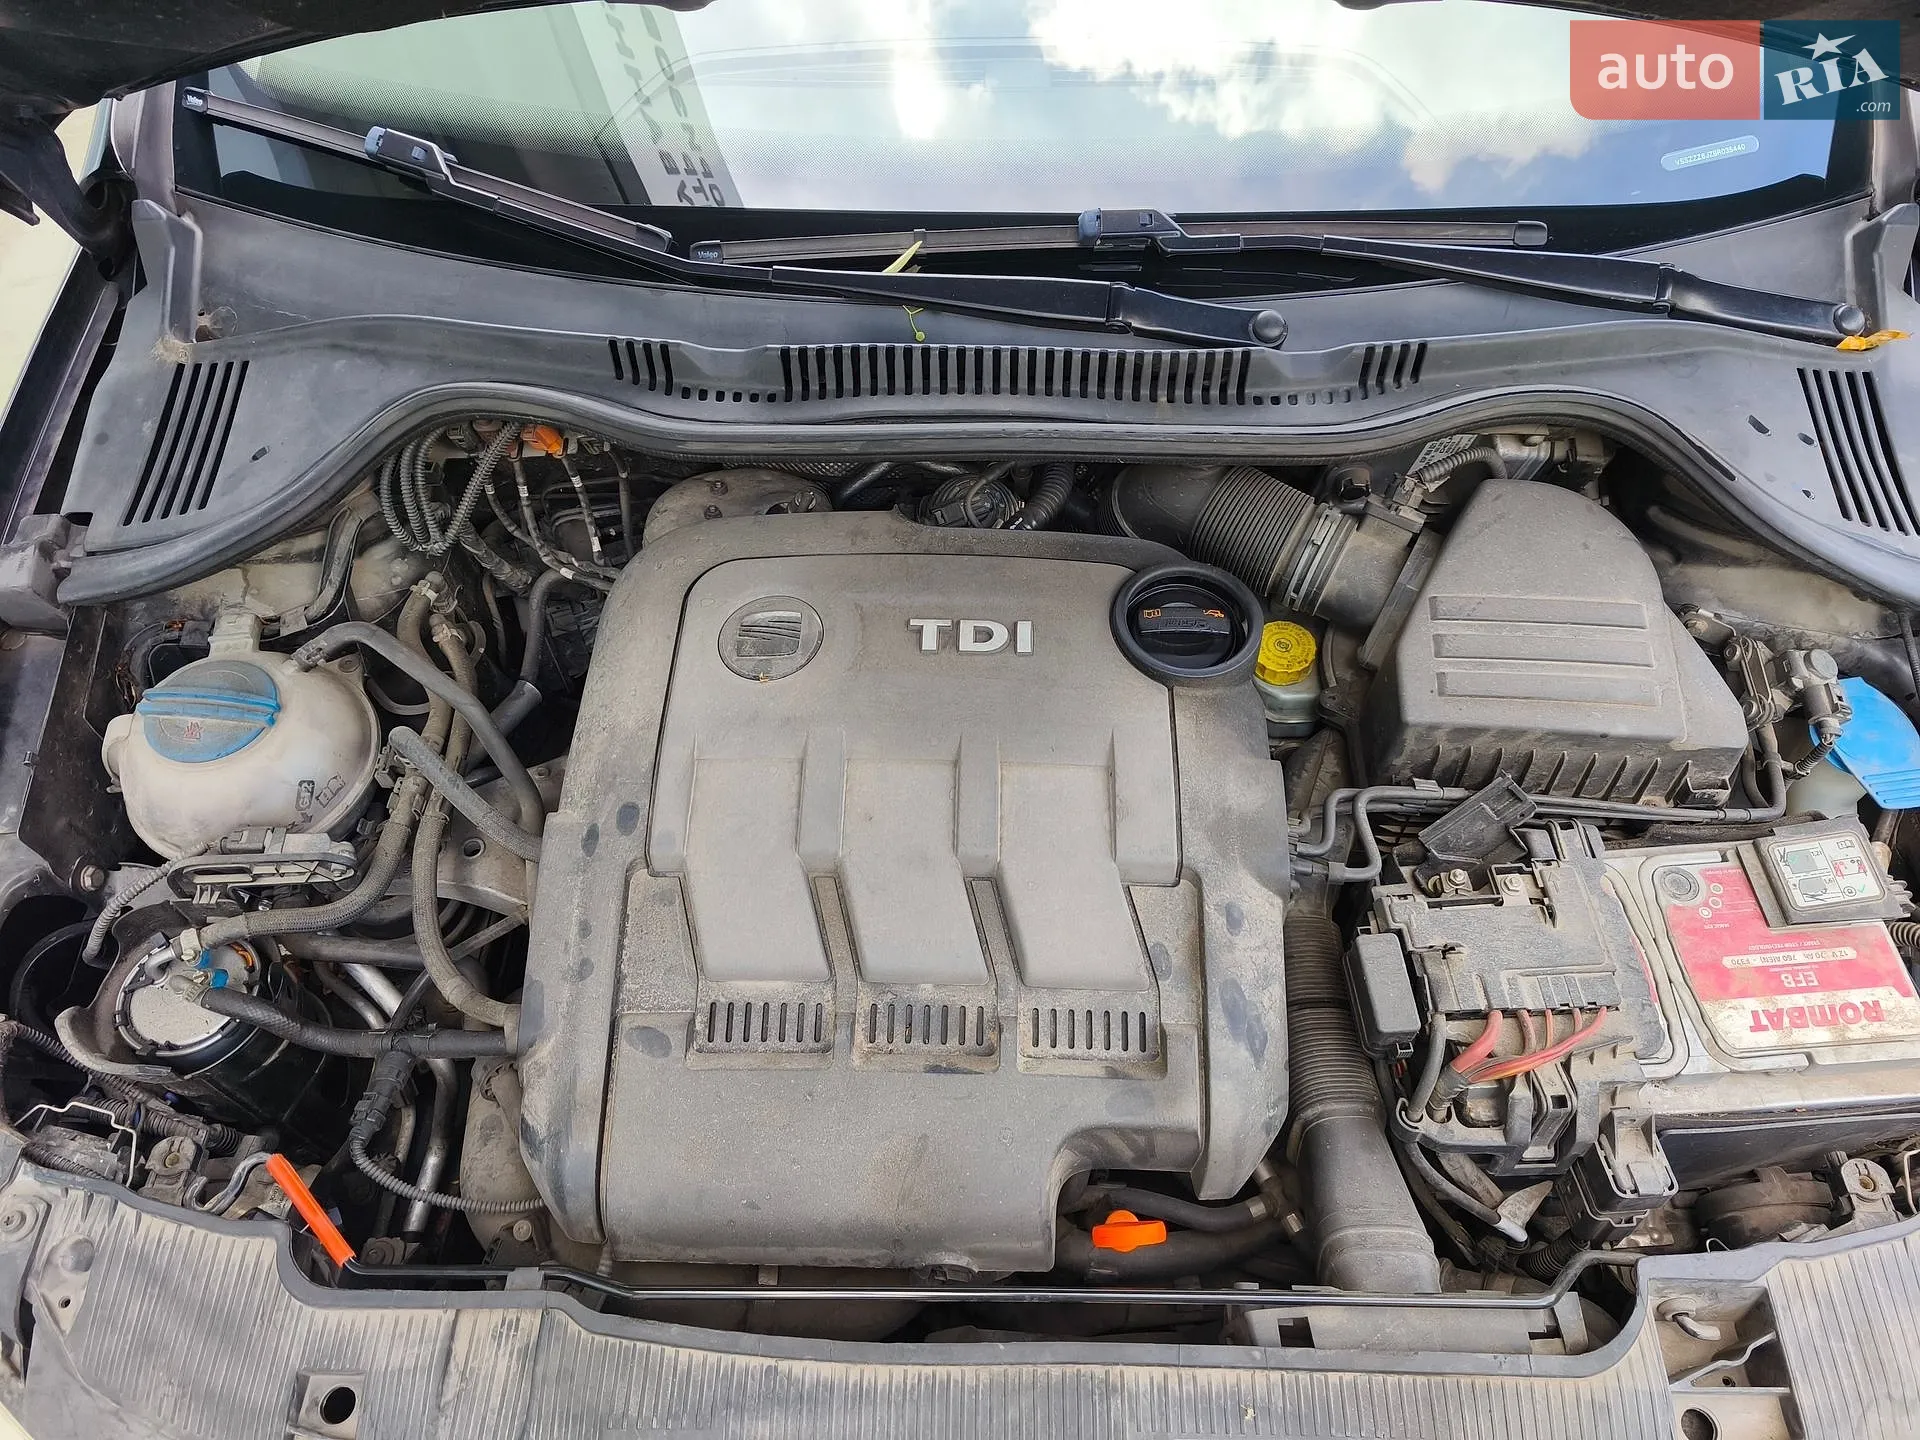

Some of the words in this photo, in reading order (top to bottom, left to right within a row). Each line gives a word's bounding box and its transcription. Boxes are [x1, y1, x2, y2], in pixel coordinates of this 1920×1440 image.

[697, 251, 718, 260] Valeo
[908, 618, 1035, 657] TDI
[1780, 971, 1818, 988] EFB
[1749, 1000, 1884, 1032] ROMBAT
